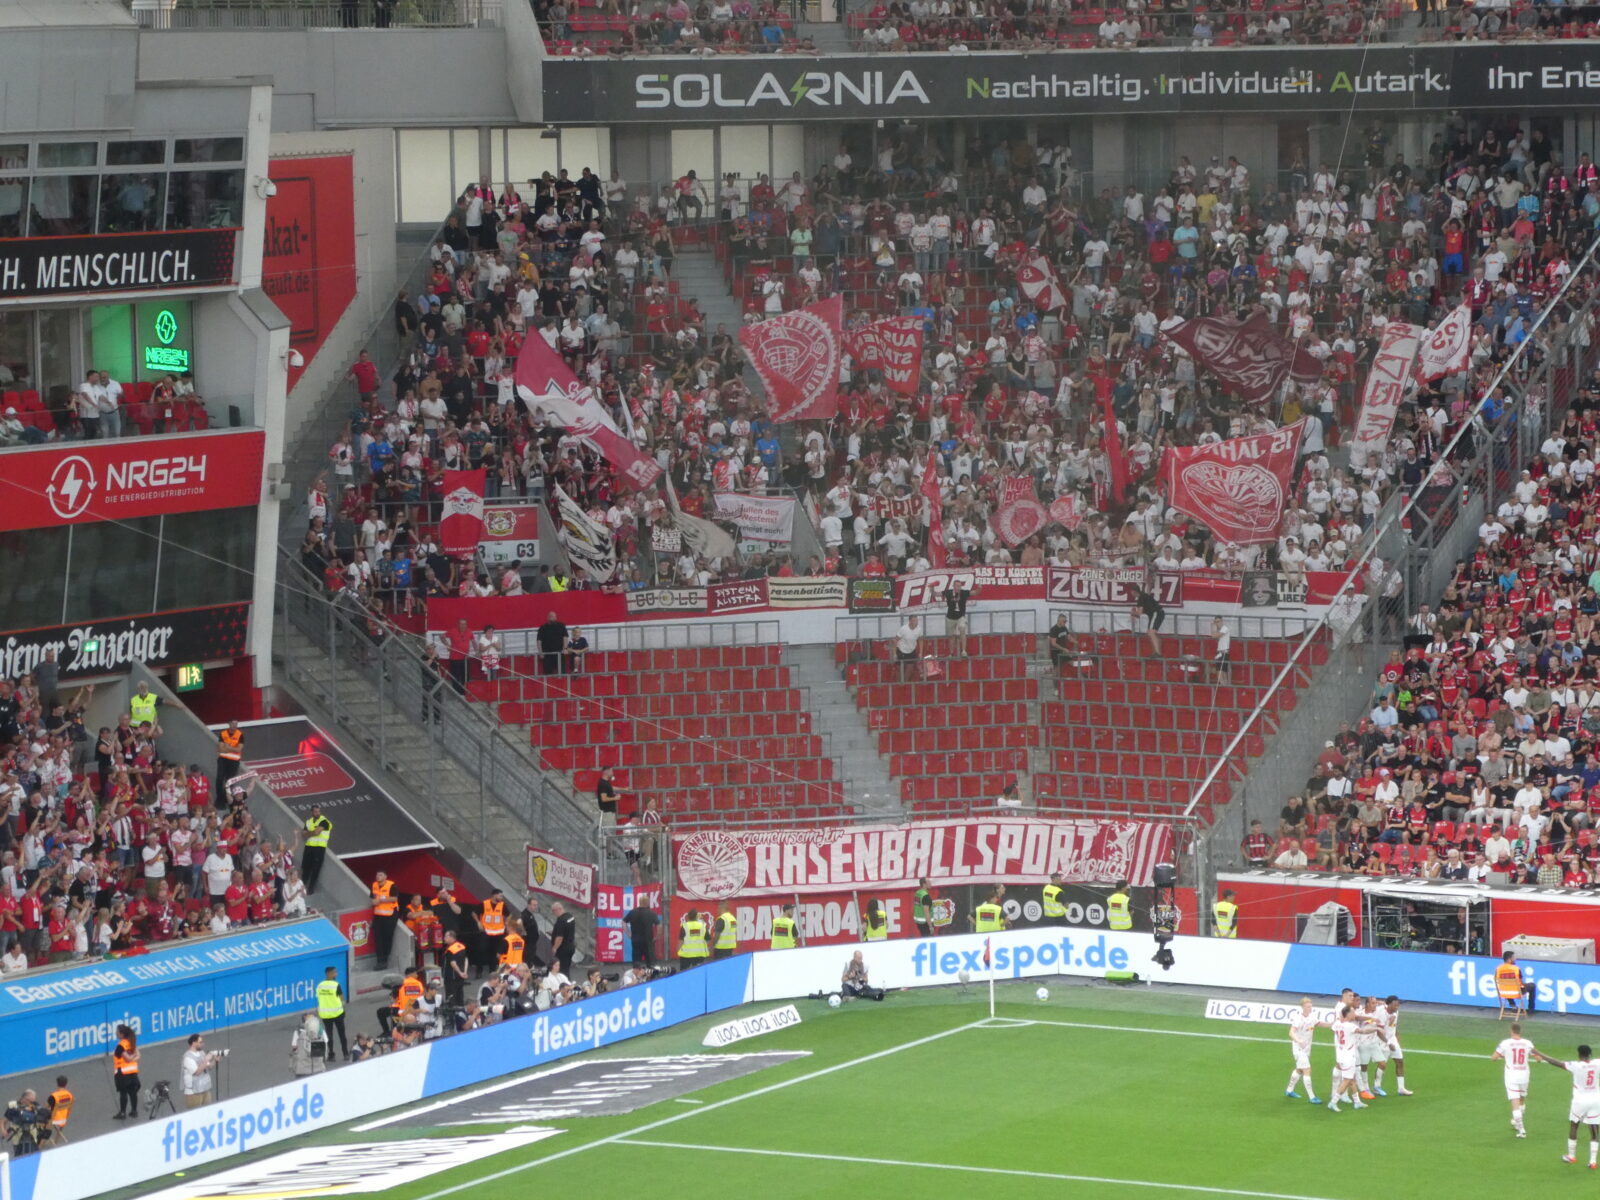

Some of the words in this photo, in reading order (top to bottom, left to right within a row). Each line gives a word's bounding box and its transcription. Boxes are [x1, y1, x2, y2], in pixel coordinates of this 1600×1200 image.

[635, 70, 931, 108] SOLARNIA
[966, 73, 1150, 101] Nachhaltig.
[1159, 70, 1322, 95] Individuell.
[1329, 68, 1450, 93] Autark.
[1488, 66, 1533, 90] Ihr
[0, 257, 26, 291] H.
[36, 249, 197, 290] MENSCHLICH.
[105, 454, 207, 492] NRG24
[104, 495, 118, 504] DIE
[120, 486, 205, 503] ENERGIEDISTRIBUTION
[516, 542, 536, 558] G3
[770, 585, 844, 596] rasenballisten
[1051, 571, 1129, 602] ZONE
[1080, 569, 1105, 580] ZONE
[65, 620, 174, 672] Anzeiger
[680, 831, 743, 867] RASENBALLSPORT
[754, 822, 1100, 888] RASENBALLSPORT
[607, 930, 623, 950] 2
[5, 964, 129, 1004] Barmenia
[129, 948, 212, 980] EINFACH.
[206, 932, 321, 966] MENSCHLICH.
[224, 978, 318, 1017] MENSCHLICH.
[1210, 1001, 1251, 1019] iLOQ
[532, 987, 666, 1056] flexispot.de
[714, 1023, 742, 1044] iLOQ
[743, 1014, 772, 1038] iLOQ
[772, 1007, 799, 1029] iLOQ
[1512, 1048, 1526, 1065] 16
[1586, 1070, 1596, 1086] 5
[162, 1083, 325, 1163] flexispot.de
